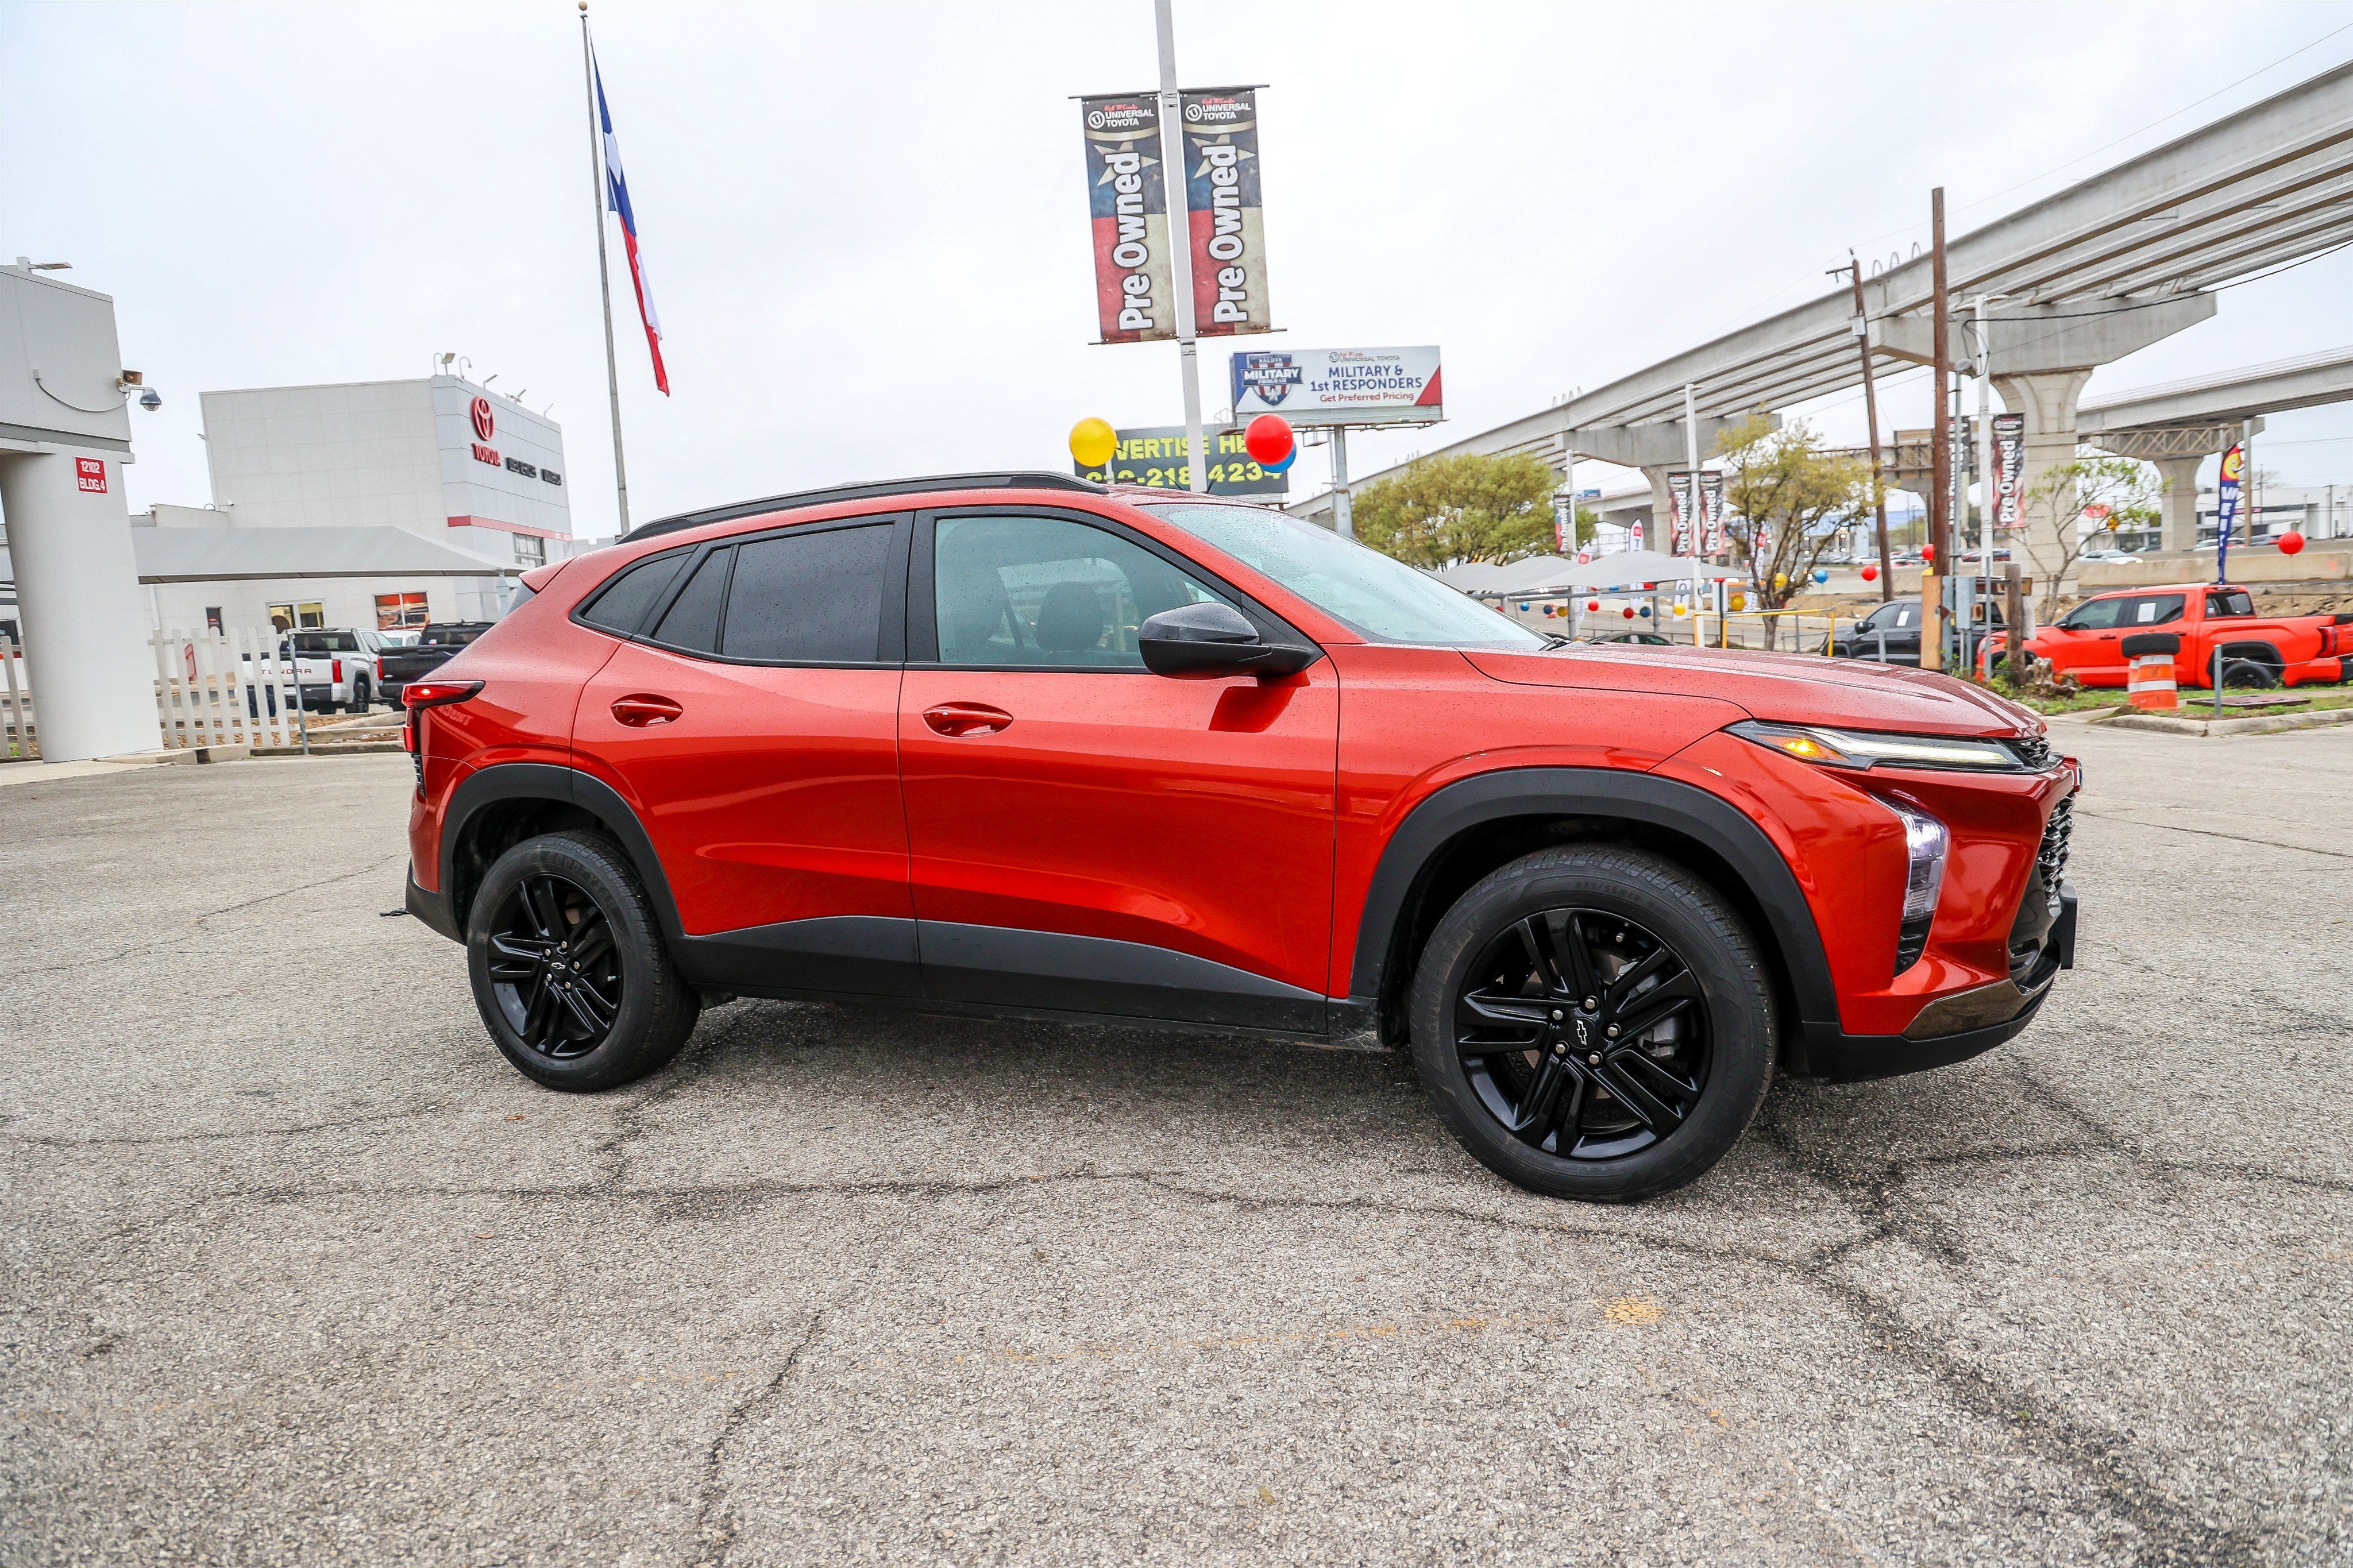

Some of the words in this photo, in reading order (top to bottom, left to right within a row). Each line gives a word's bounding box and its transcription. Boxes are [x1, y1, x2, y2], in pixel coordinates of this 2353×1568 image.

[1105, 109, 1155, 119] UNIVERSAL
[1202, 102, 1252, 113] UNIVERSAL
[1203, 111, 1237, 121] TOYOTA
[1105, 118, 1140, 128] TOYOTA
[1104, 152, 1148, 268] Owned
[1201, 145, 1244, 261] Owned
[1118, 275, 1154, 330] Pre
[1213, 267, 1248, 323] Pre
[1243, 368, 1299, 380] MILITARY
[1329, 365, 1391, 377] MILITARY
[1395, 364, 1403, 376] &
[1310, 380, 1329, 392] 1st
[1333, 377, 1422, 391] RESPONDERS
[1320, 393, 1336, 402] Get
[1338, 392, 1381, 401] Preferred
[1383, 391, 1414, 401] Pricing
[471, 442, 502, 466] TOYOTA
[1999, 440, 2016, 495] Owned
[1674, 490, 1689, 531] Owned
[1703, 489, 1718, 531] Owned
[1999, 496, 2016, 523] Pre
[1676, 532, 1689, 553] Pre
[1705, 531, 1719, 551] Pre
